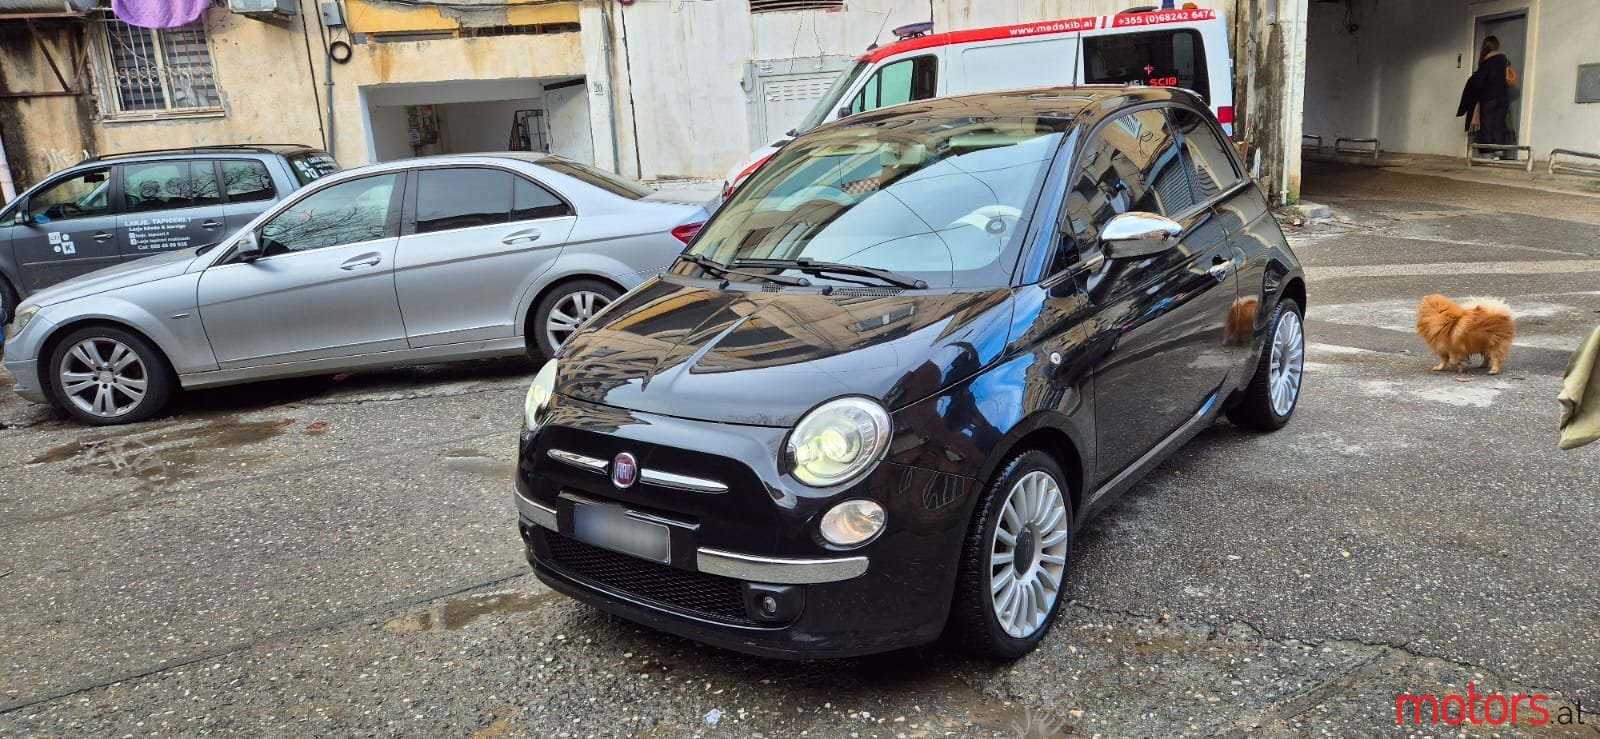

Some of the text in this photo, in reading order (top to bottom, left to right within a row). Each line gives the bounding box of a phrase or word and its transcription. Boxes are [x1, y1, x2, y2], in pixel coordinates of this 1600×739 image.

[1009, 10, 1216, 36] www.medskib.al +355 (0)68242 6474
[616, 462, 633, 479] FIAT
